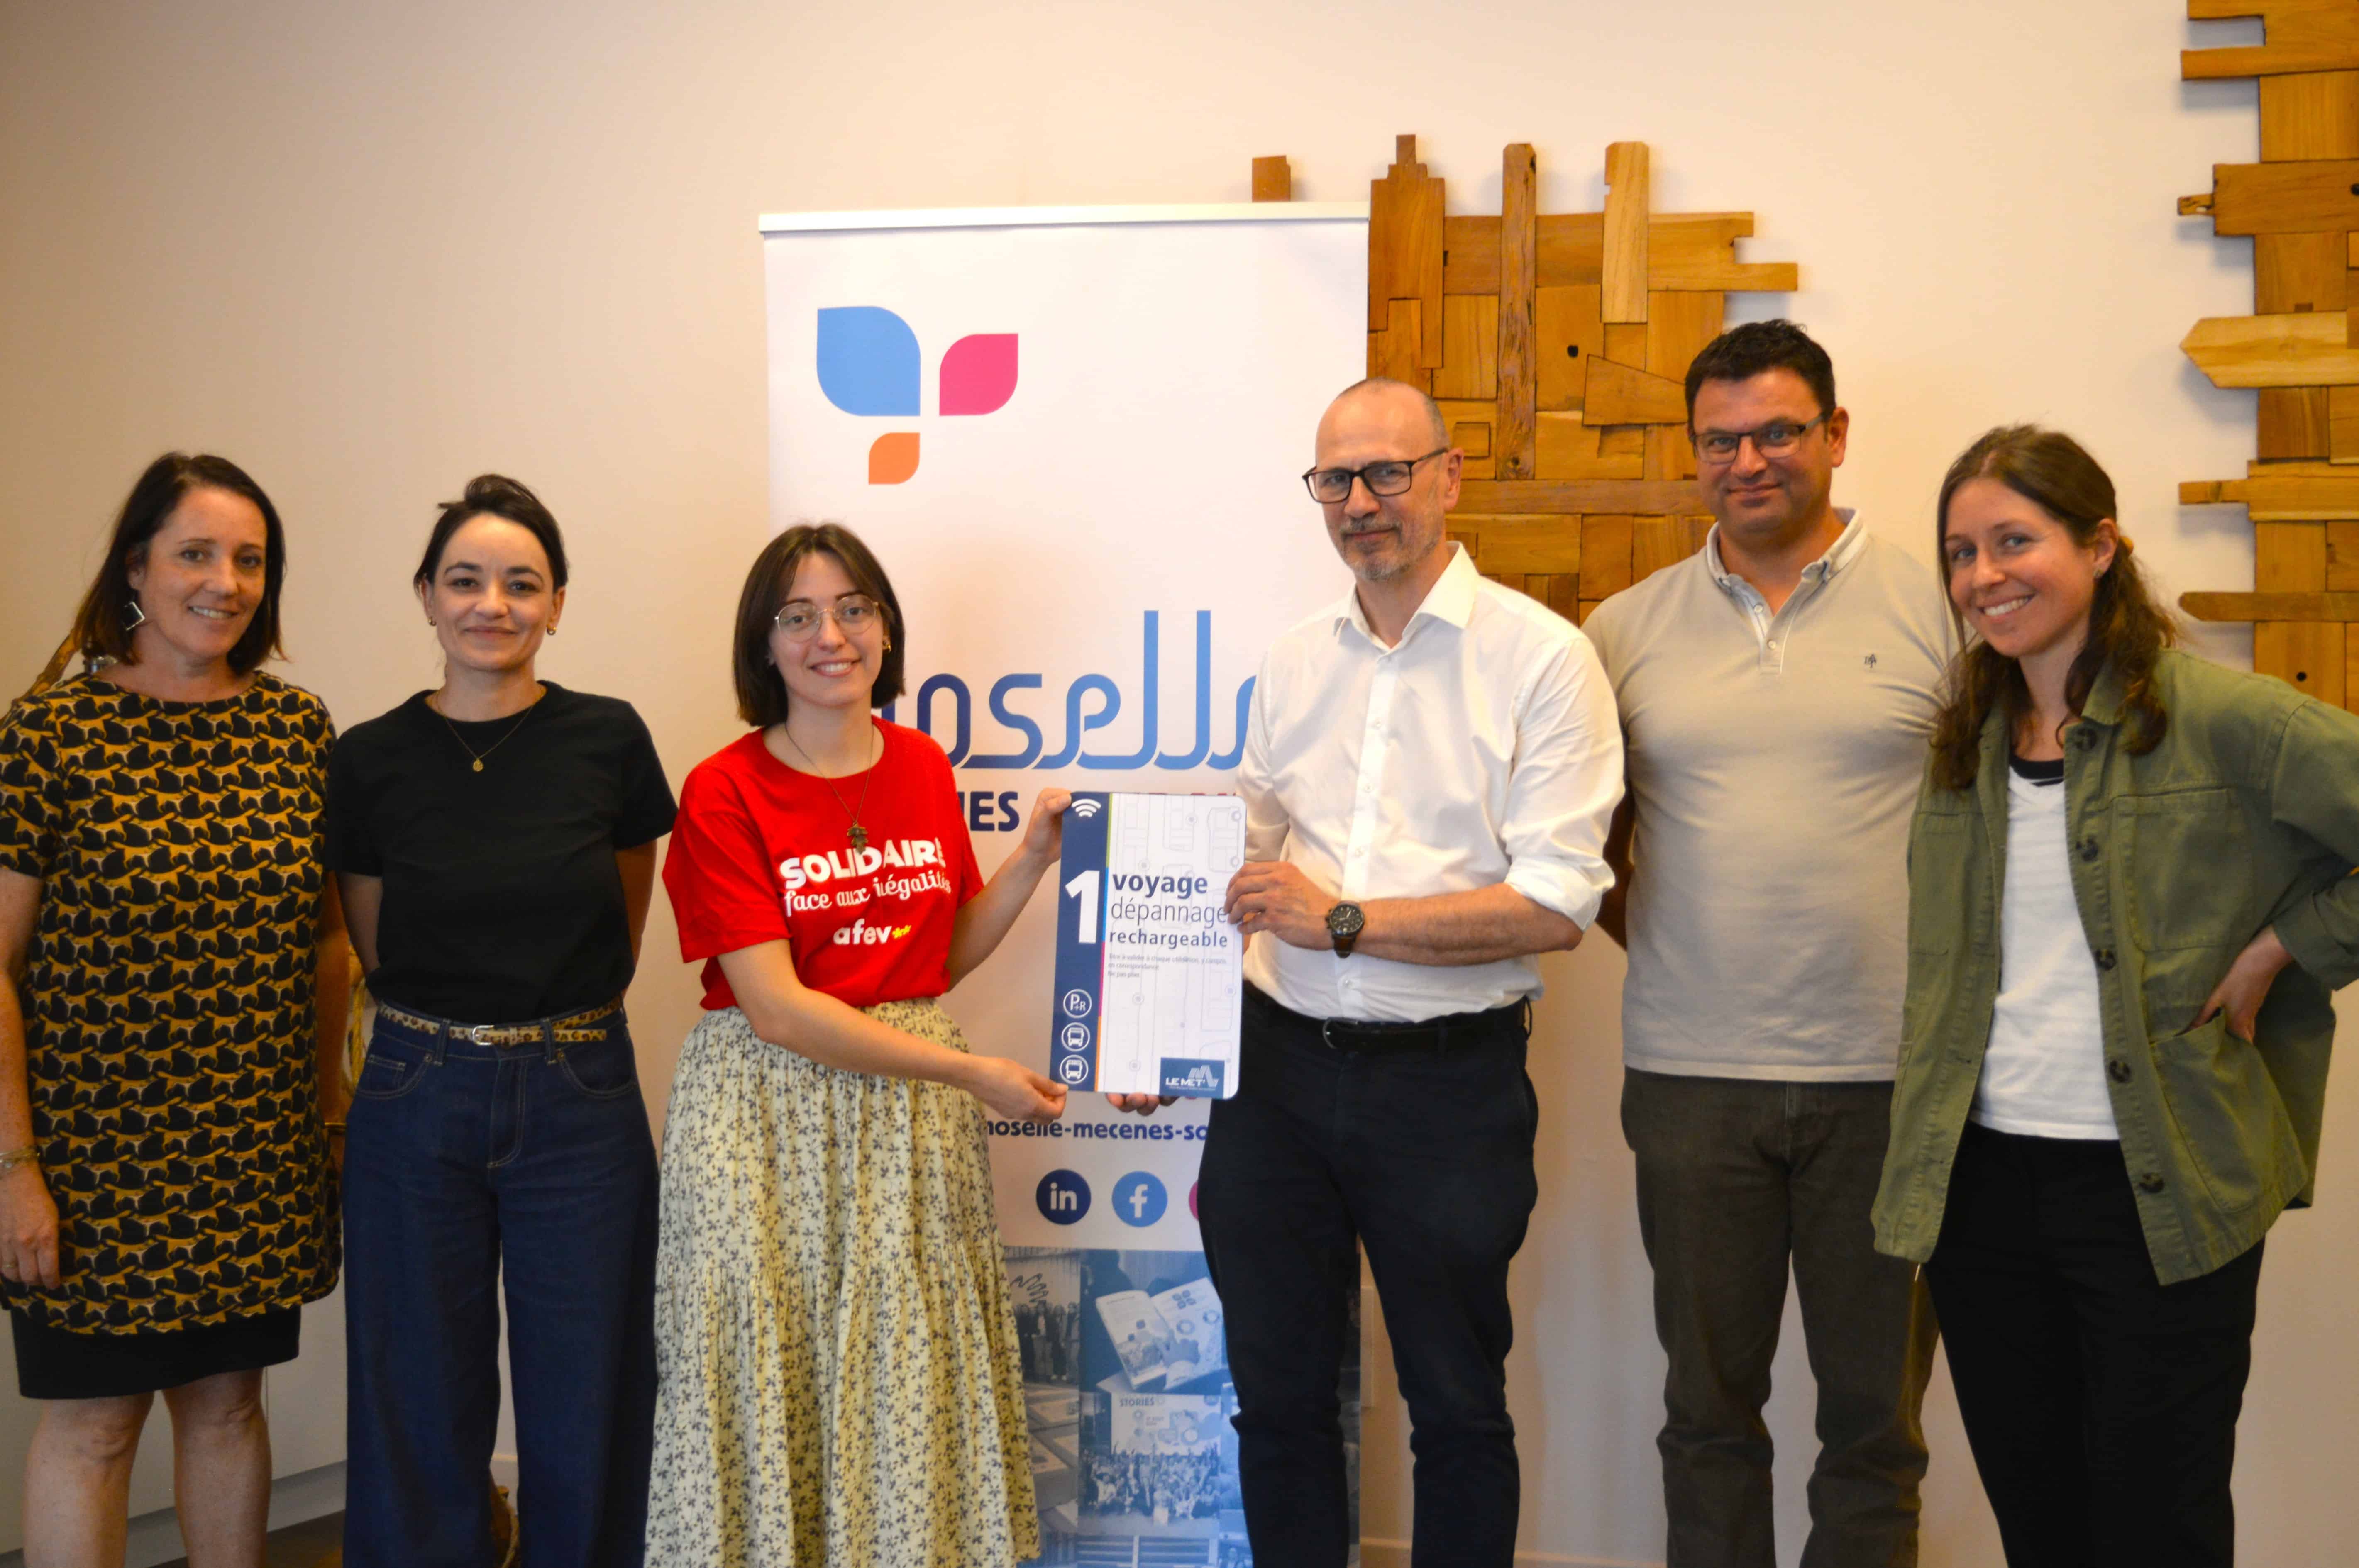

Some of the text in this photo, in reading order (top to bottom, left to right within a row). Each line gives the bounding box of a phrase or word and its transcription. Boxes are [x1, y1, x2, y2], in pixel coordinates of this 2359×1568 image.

[881, 609, 1257, 771] osell
[1113, 874, 1208, 900] voyage
[784, 890, 833, 918] face
[836, 887, 871, 907] aux
[1065, 870, 1100, 944] 1
[1111, 896, 1228, 929] dépannage
[833, 918, 893, 946] afev
[1109, 929, 1228, 949] rechargeable
[1165, 1078, 1179, 1086] LE
[1120, 1397, 1154, 1406] STORIES
